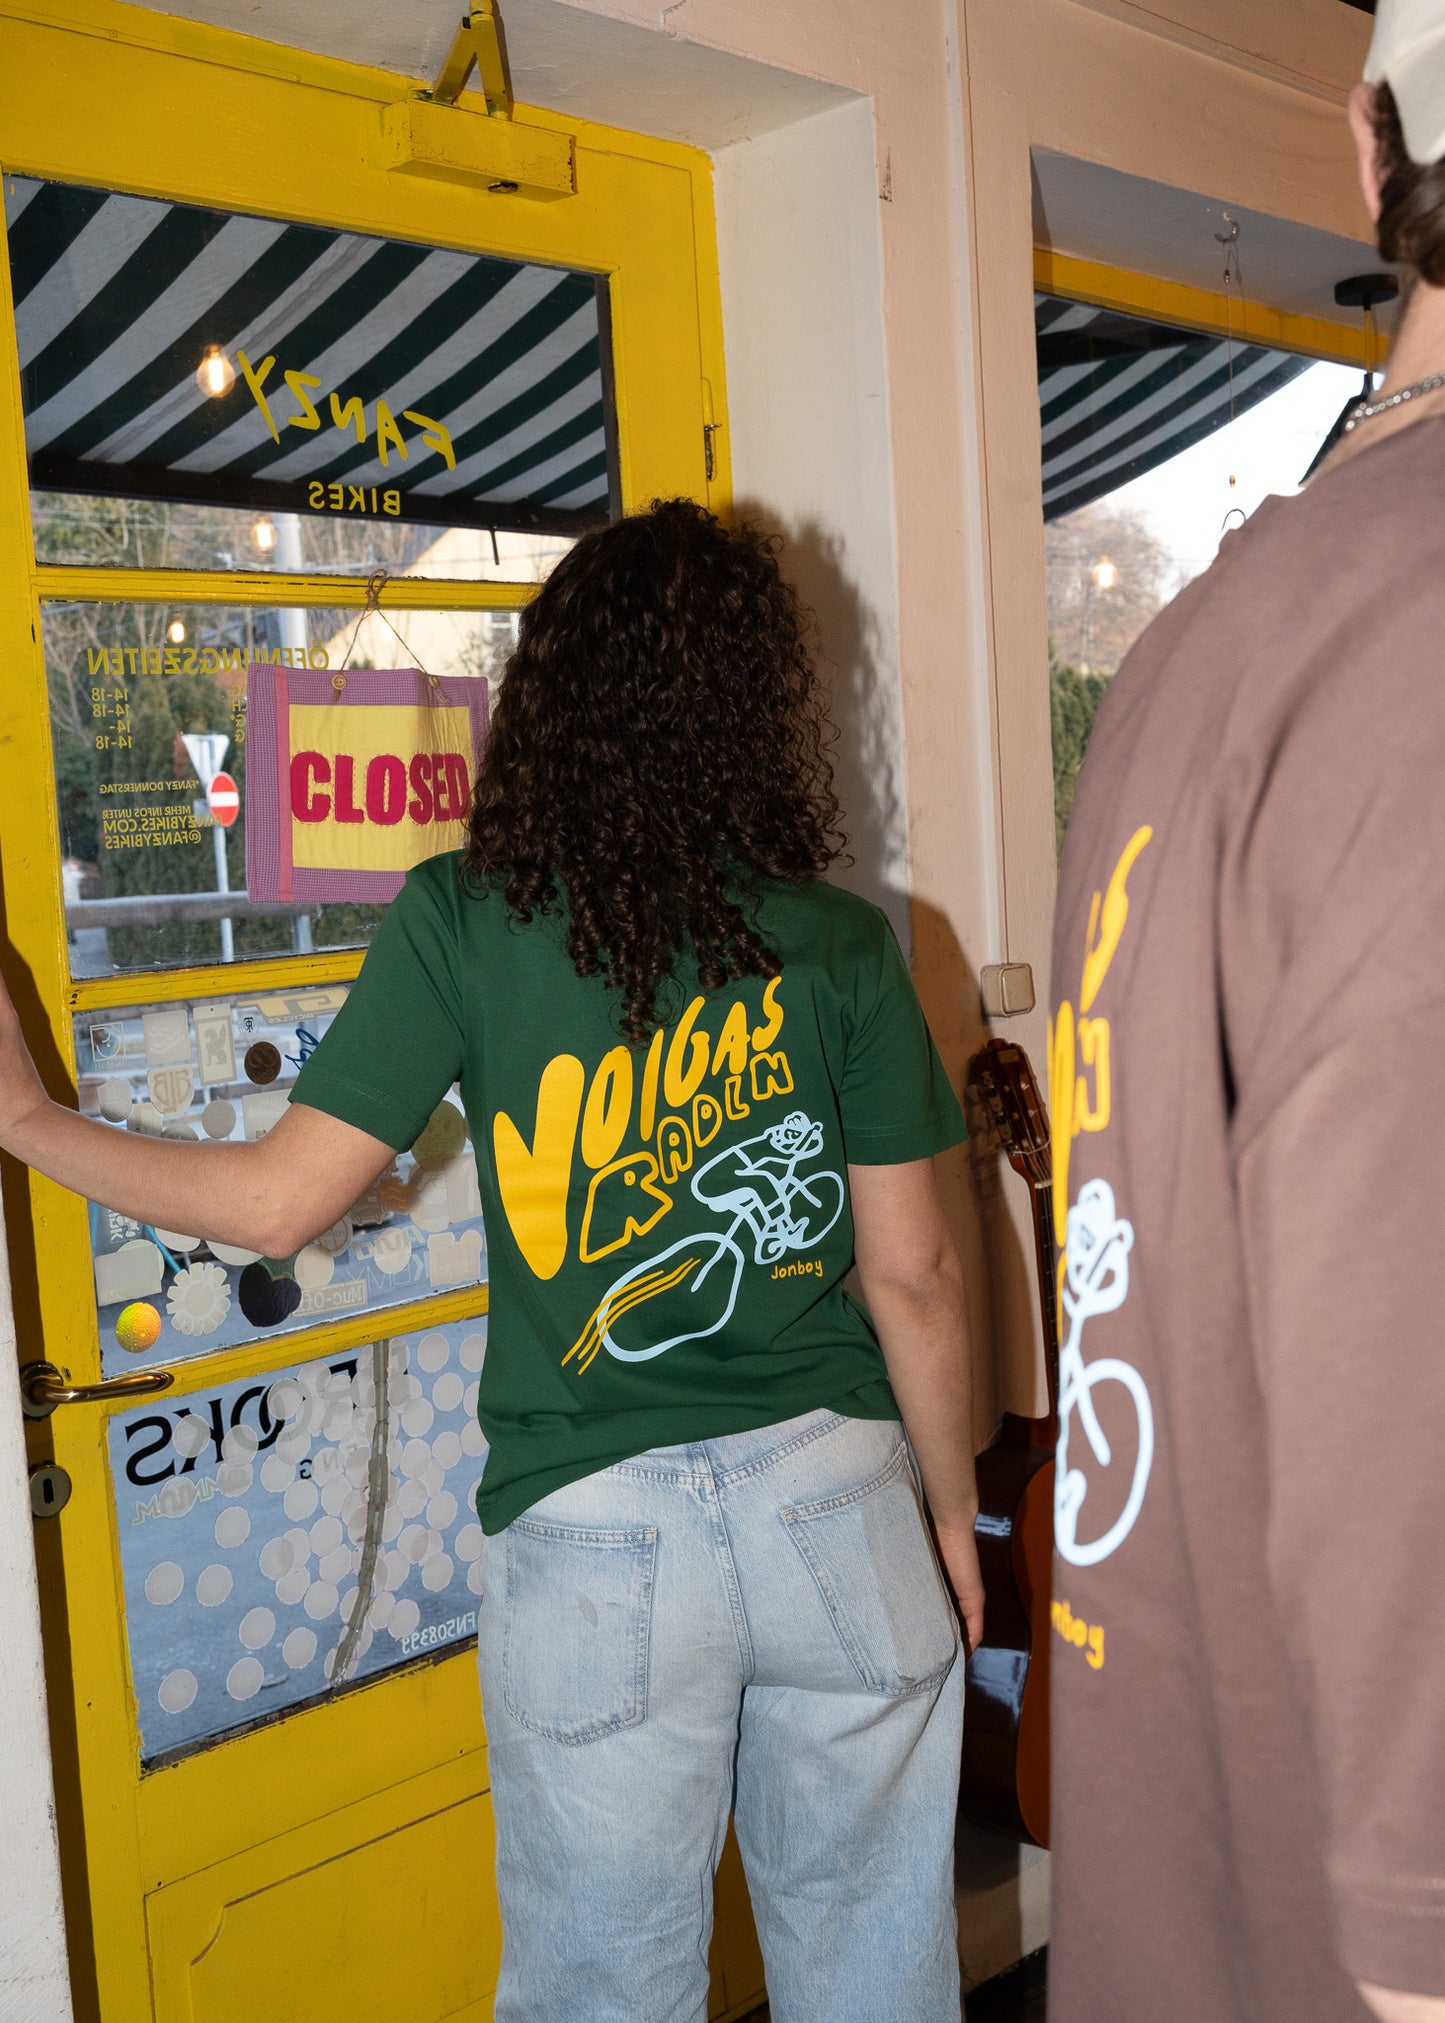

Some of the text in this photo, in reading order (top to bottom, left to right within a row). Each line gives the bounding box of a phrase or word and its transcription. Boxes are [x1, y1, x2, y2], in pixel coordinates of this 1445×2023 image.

[290, 751, 474, 826] CLOSED
[580, 1051, 794, 1263] RADLN
[770, 1259, 824, 1280] Jonboy
